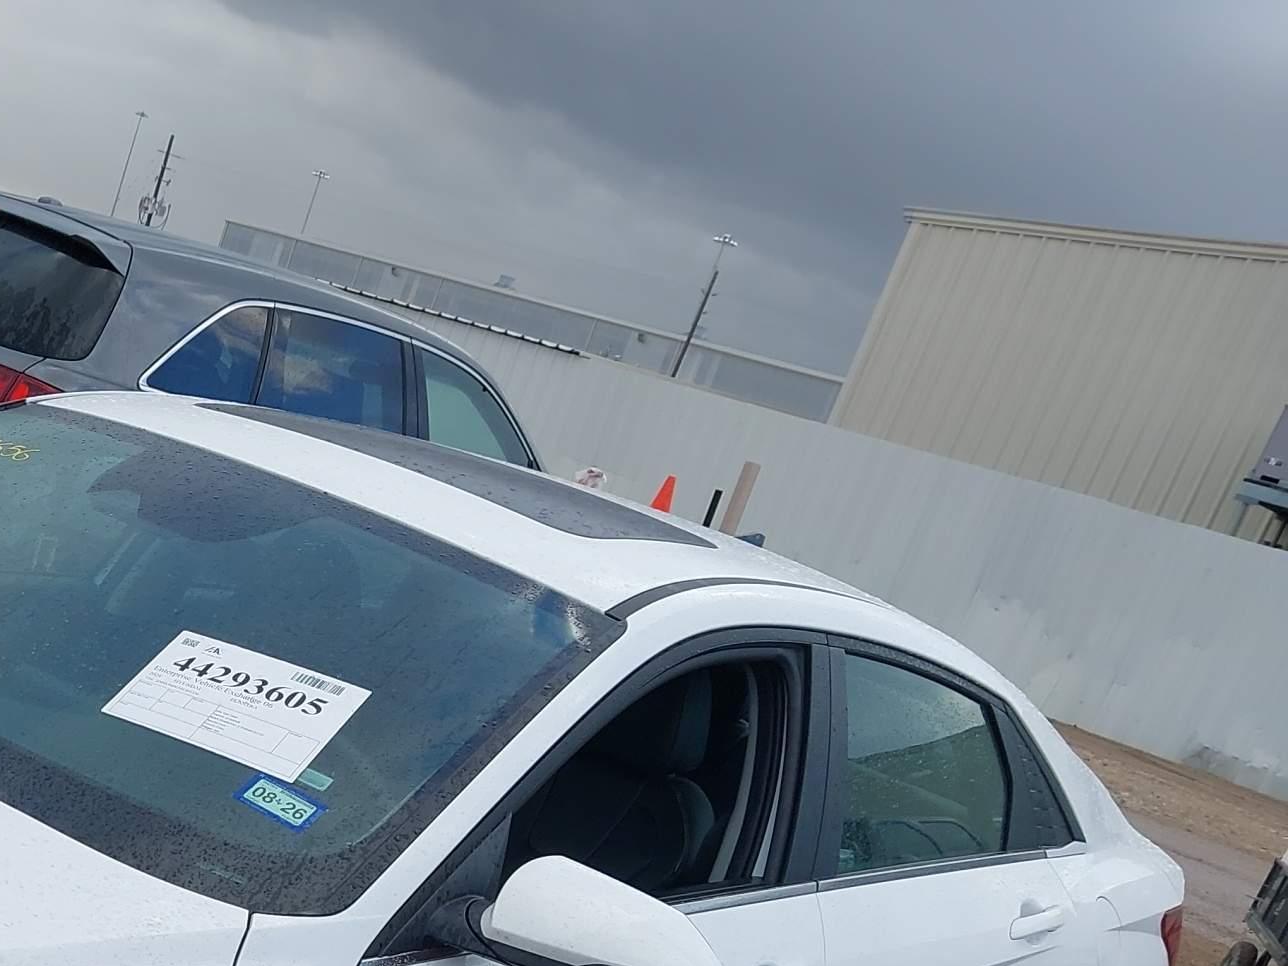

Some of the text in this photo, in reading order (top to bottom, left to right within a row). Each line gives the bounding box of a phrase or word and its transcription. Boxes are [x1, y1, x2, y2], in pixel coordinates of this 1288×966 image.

[173, 656, 328, 715] 44293605
[252, 786, 277, 804] 08
[279, 802, 308, 820] 26
